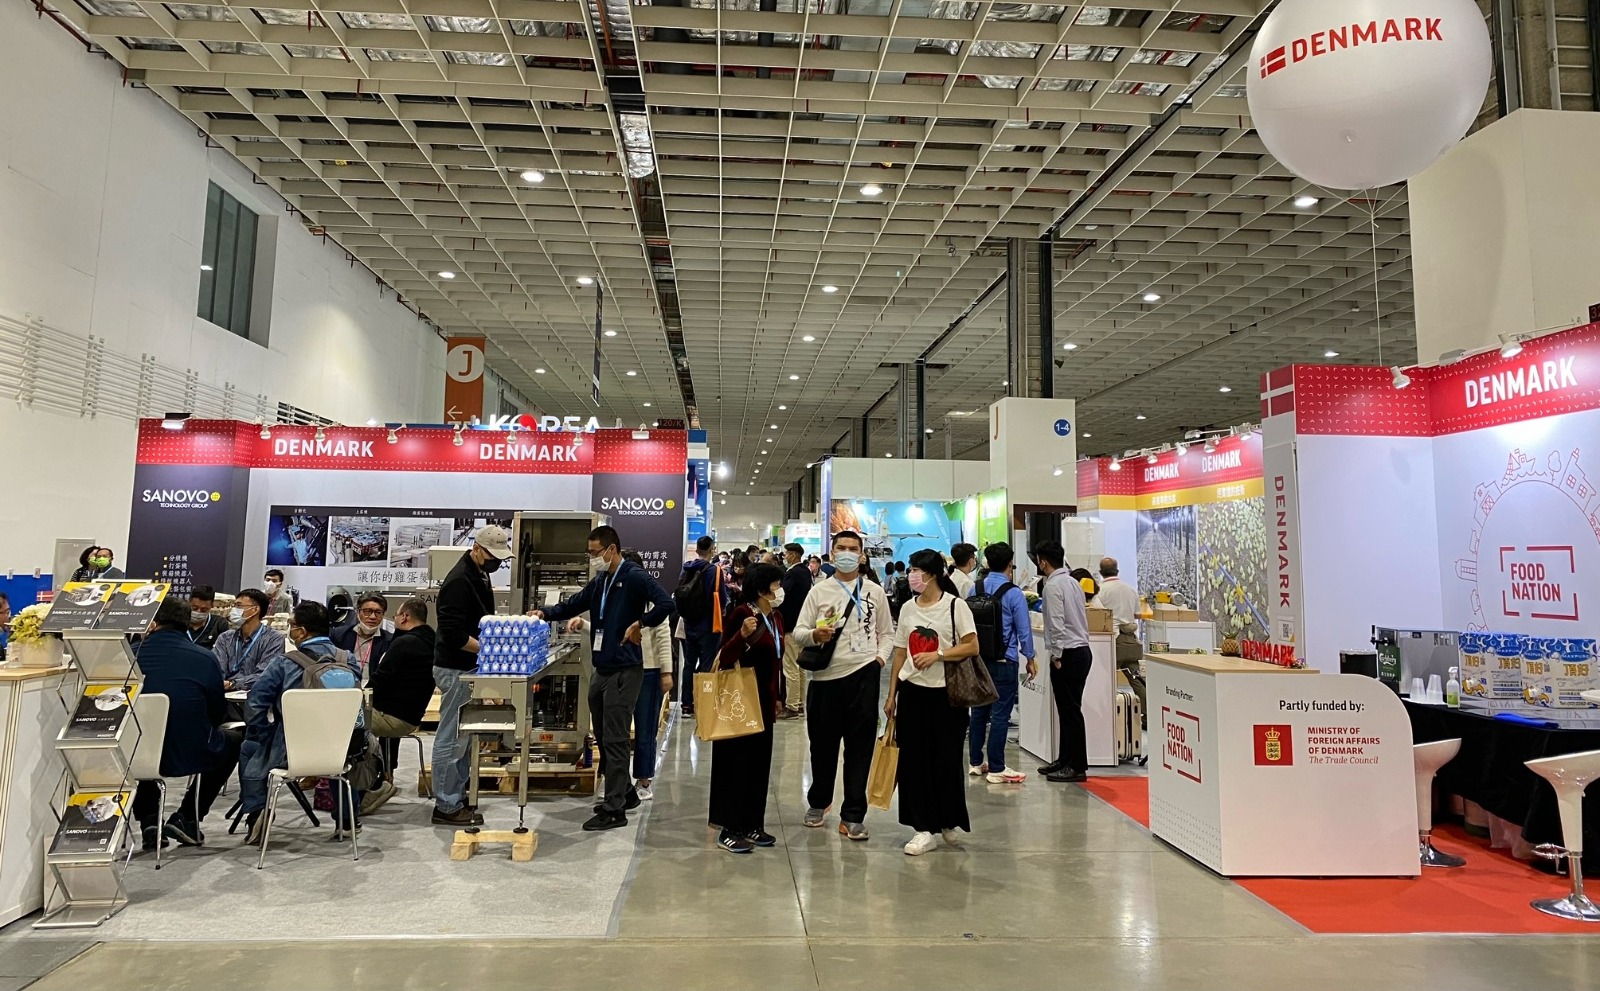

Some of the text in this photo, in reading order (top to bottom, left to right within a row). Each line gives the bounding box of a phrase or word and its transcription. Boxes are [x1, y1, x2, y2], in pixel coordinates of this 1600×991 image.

[1292, 17, 1443, 63] DENMARK
[458, 350, 473, 377] J
[1465, 355, 1578, 409] DENMARK
[993, 406, 999, 440] J
[1055, 423, 1070, 432] 1-4
[274, 438, 374, 458] DENMARK
[480, 443, 578, 462] DENMARK
[1201, 449, 1242, 473] DENMARK
[1144, 462, 1179, 482] DENMARK
[142, 489, 209, 503] SANOVO
[601, 497, 664, 511] SANOVO
[1274, 475, 1291, 608] DENMARK
[1511, 563, 1545, 582] FOOD
[1512, 582, 1561, 602] NATION
[1241, 639, 1295, 667] DENMARK
[1563, 663, 1589, 677] 頂好
[1165, 686, 1181, 700] Branding
[1279, 699, 1365, 713] Partly funded by:
[1167, 722, 1186, 744] FOOD
[1307, 727, 1361, 735] MINISTRY OF
[1308, 737, 1381, 745] FOREIGN AFFAIRS
[1168, 739, 1194, 765] NATION
[1308, 747, 1364, 755] OF DENMARK
[1309, 756, 1379, 764] The Trade Council
